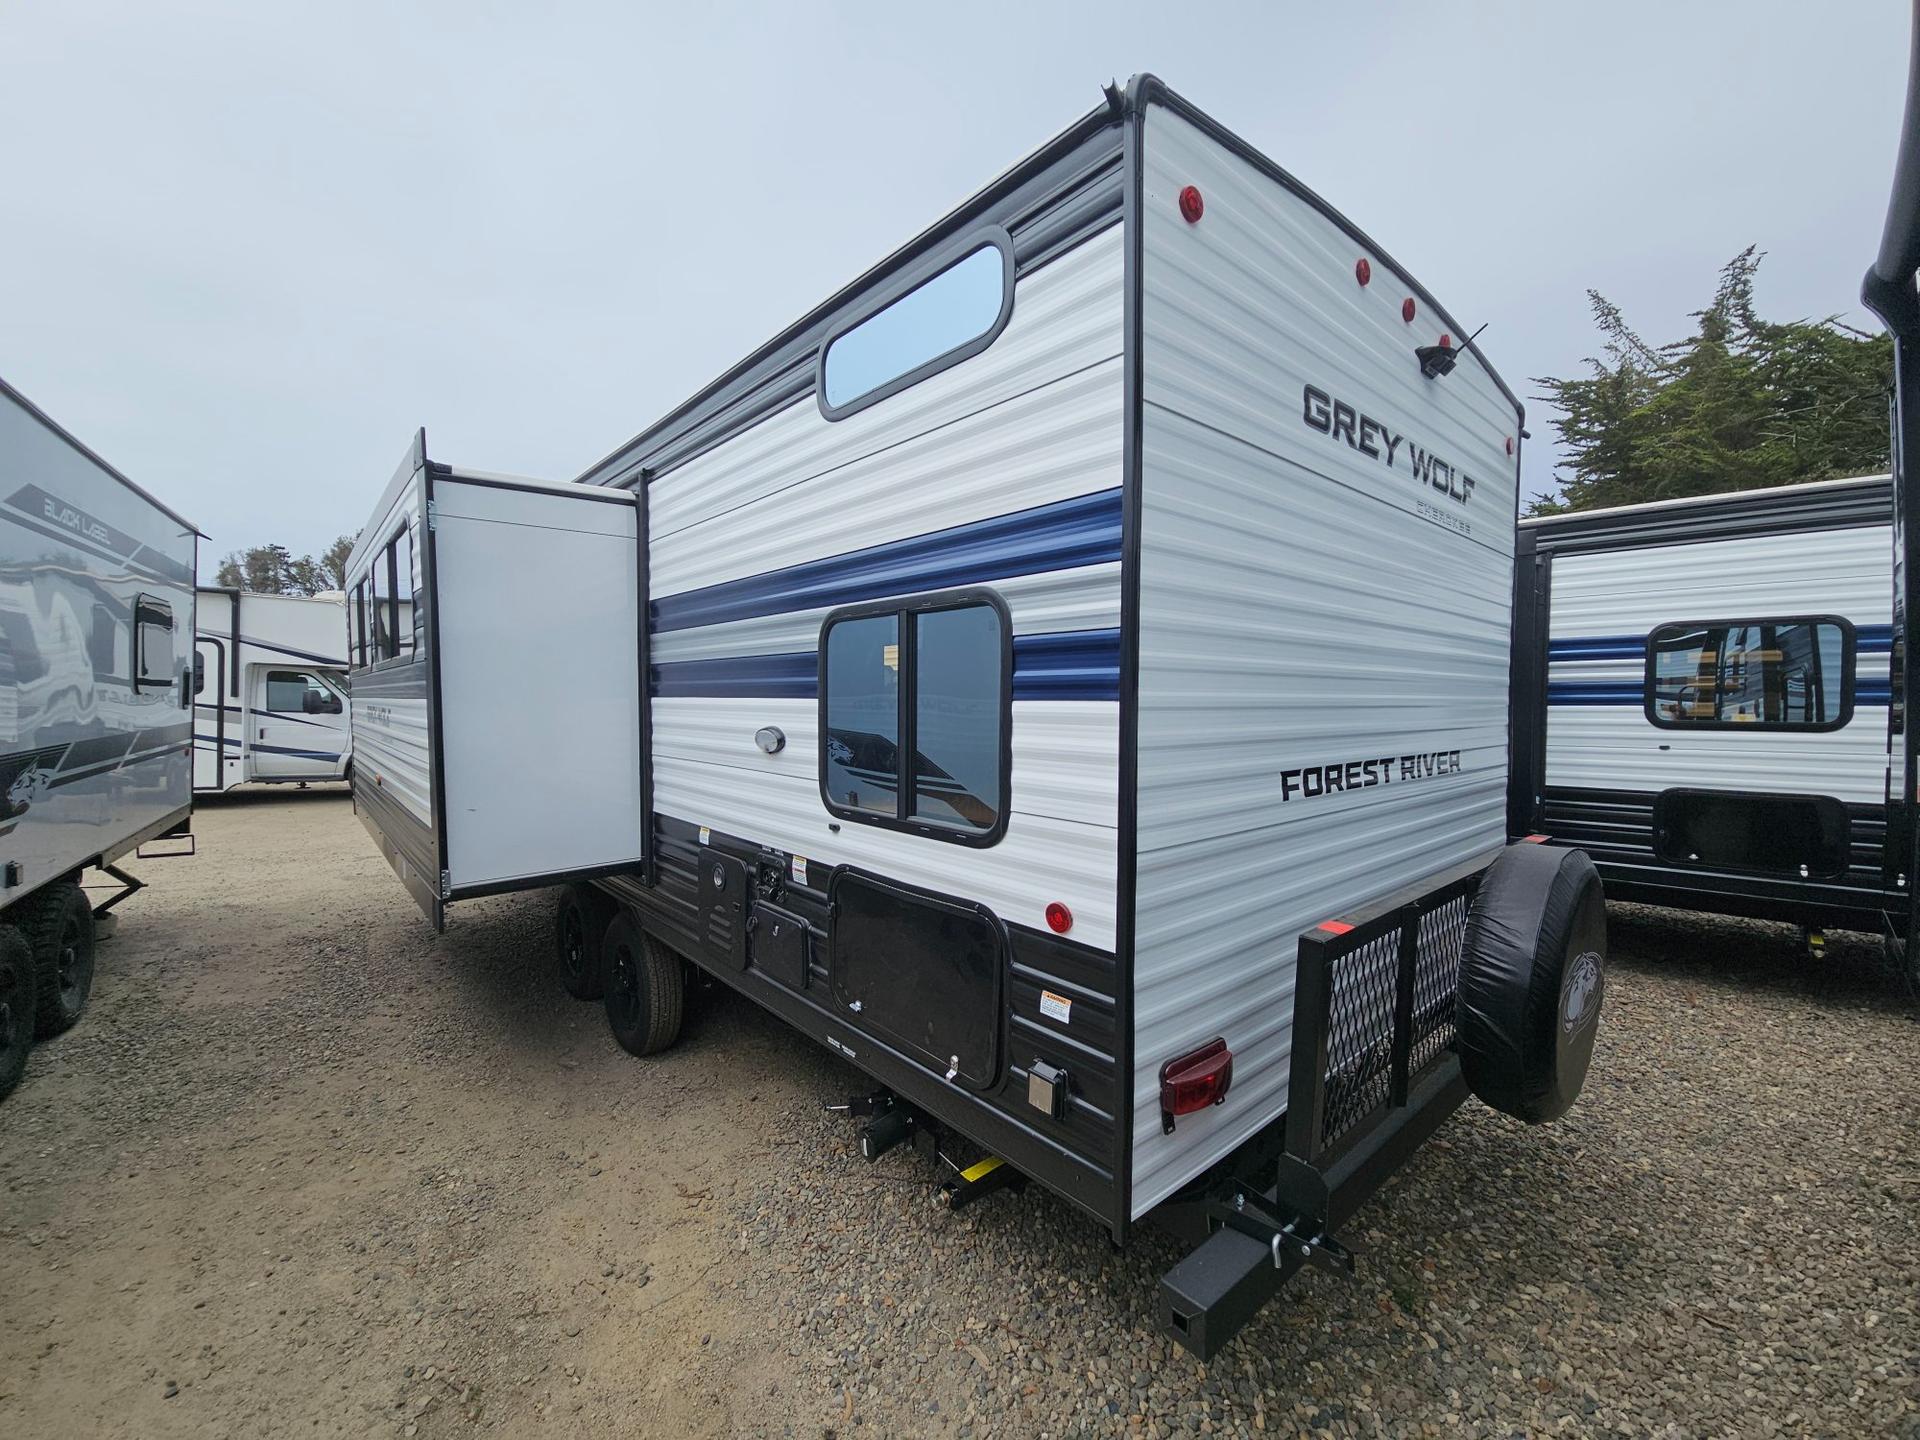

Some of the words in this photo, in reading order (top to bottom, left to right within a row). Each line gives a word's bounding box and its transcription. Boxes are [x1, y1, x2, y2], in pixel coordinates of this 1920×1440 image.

[1303, 383, 1404, 469] GREY
[1409, 441, 1475, 506] WOLF
[44, 499, 81, 532] BLACK
[82, 517, 111, 545] LABEL
[1280, 757, 1396, 802] FOREST
[1400, 750, 1462, 782] RIVER
